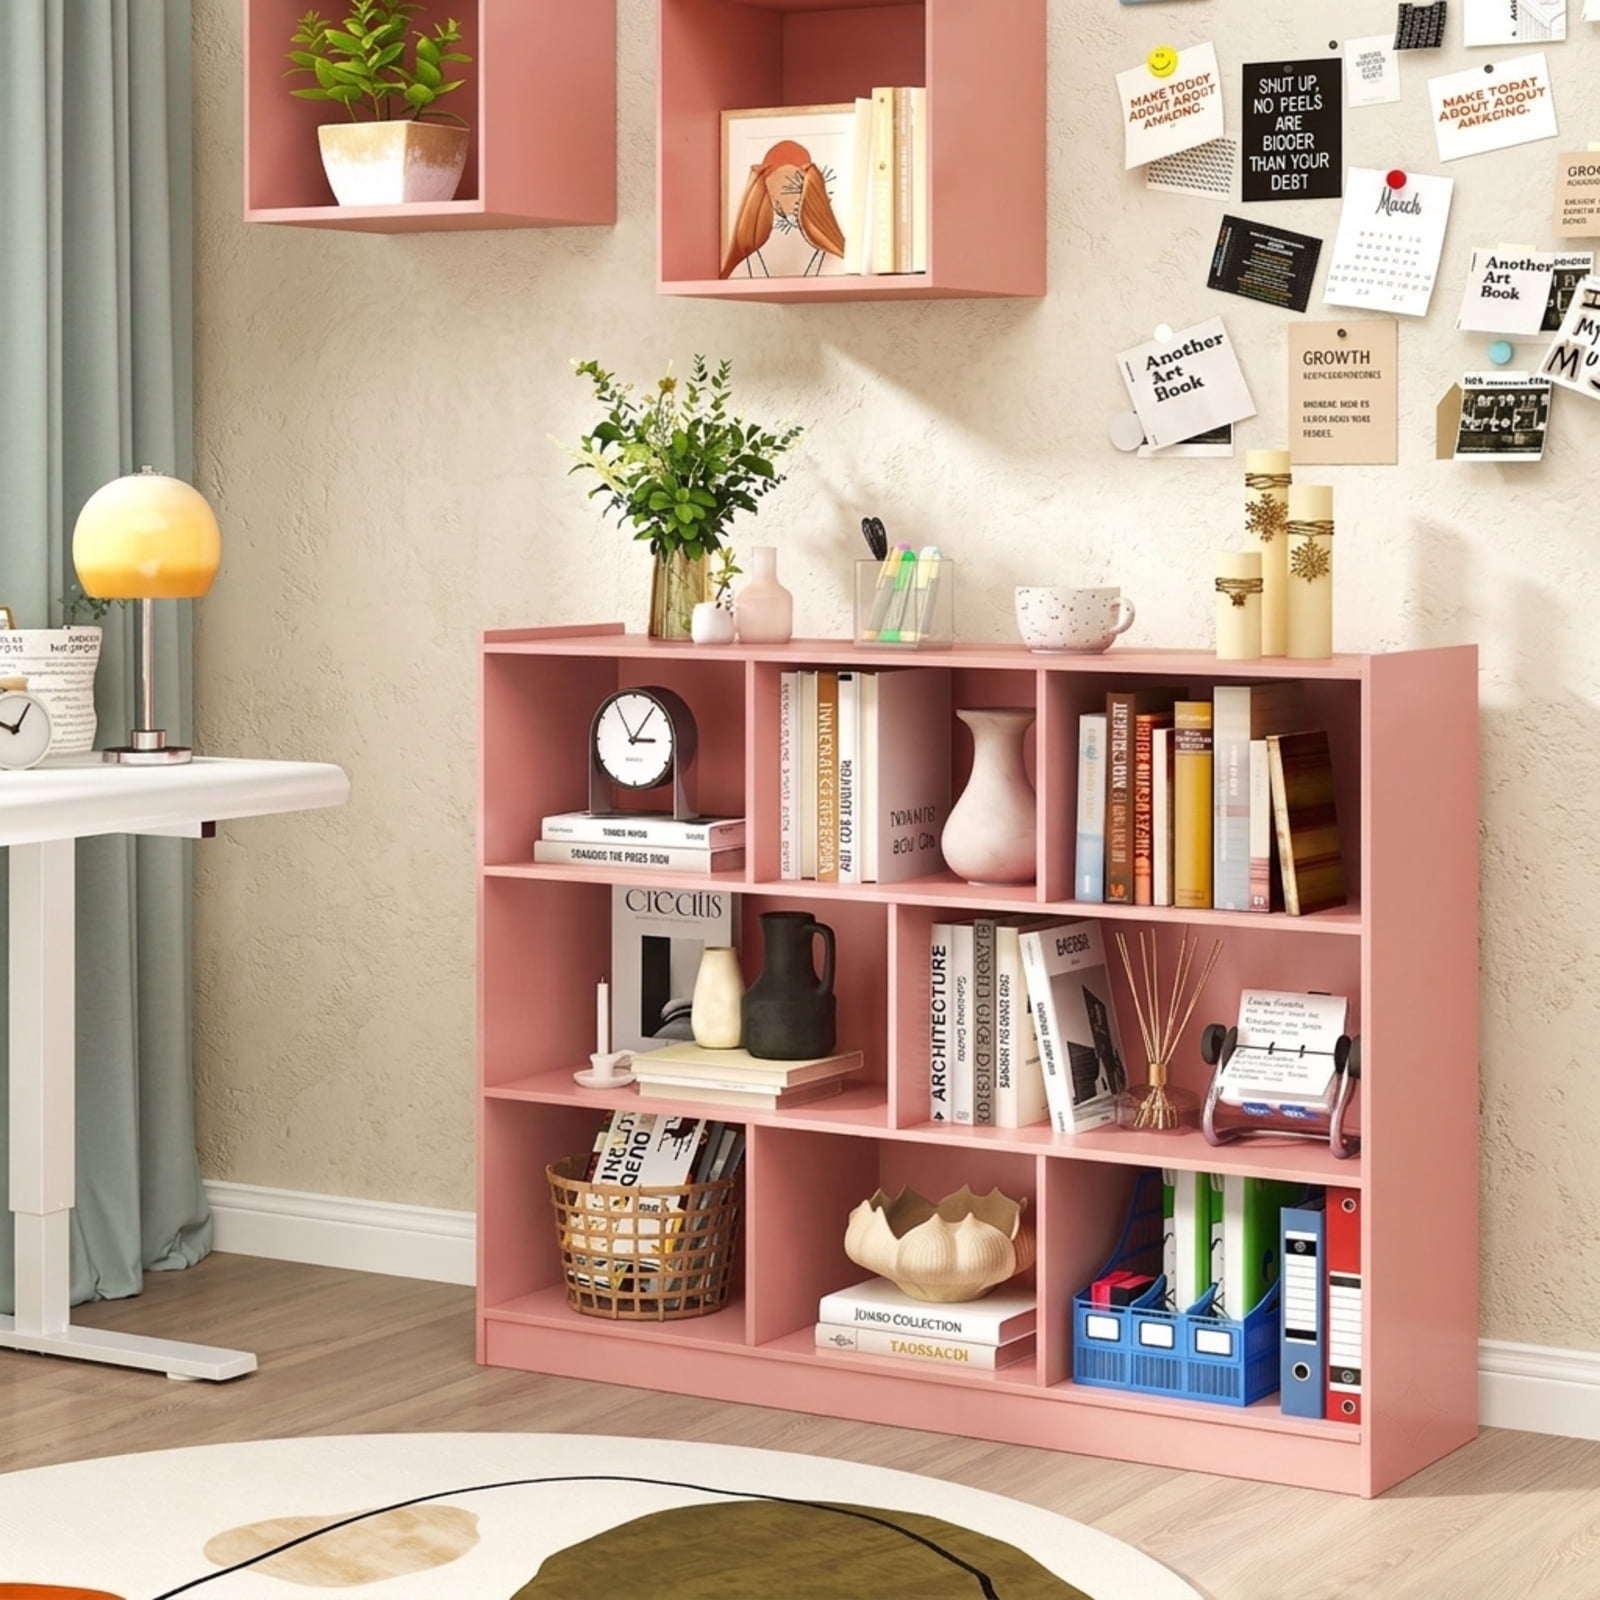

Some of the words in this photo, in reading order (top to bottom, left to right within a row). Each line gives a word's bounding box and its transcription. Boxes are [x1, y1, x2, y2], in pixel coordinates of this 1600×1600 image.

[1130, 88, 1167, 108] MAKE
[1253, 97, 1274, 115] NO
[1442, 90, 1485, 108] MAKE
[1439, 100, 1489, 122] ABOUT
[1275, 115, 1303, 132] ARE
[1249, 154, 1287, 172] THAN
[1374, 186, 1422, 217] March
[1485, 256, 1554, 272] Another
[1483, 271, 1511, 285] Art
[1481, 285, 1520, 300] Book
[1146, 334, 1224, 371] Another
[1302, 349, 1370, 366] GROWTH
[1152, 365, 1184, 385] Art
[931, 944, 947, 1102] ARCHITECTURE
[893, 1313, 962, 1333] COLLECTION
